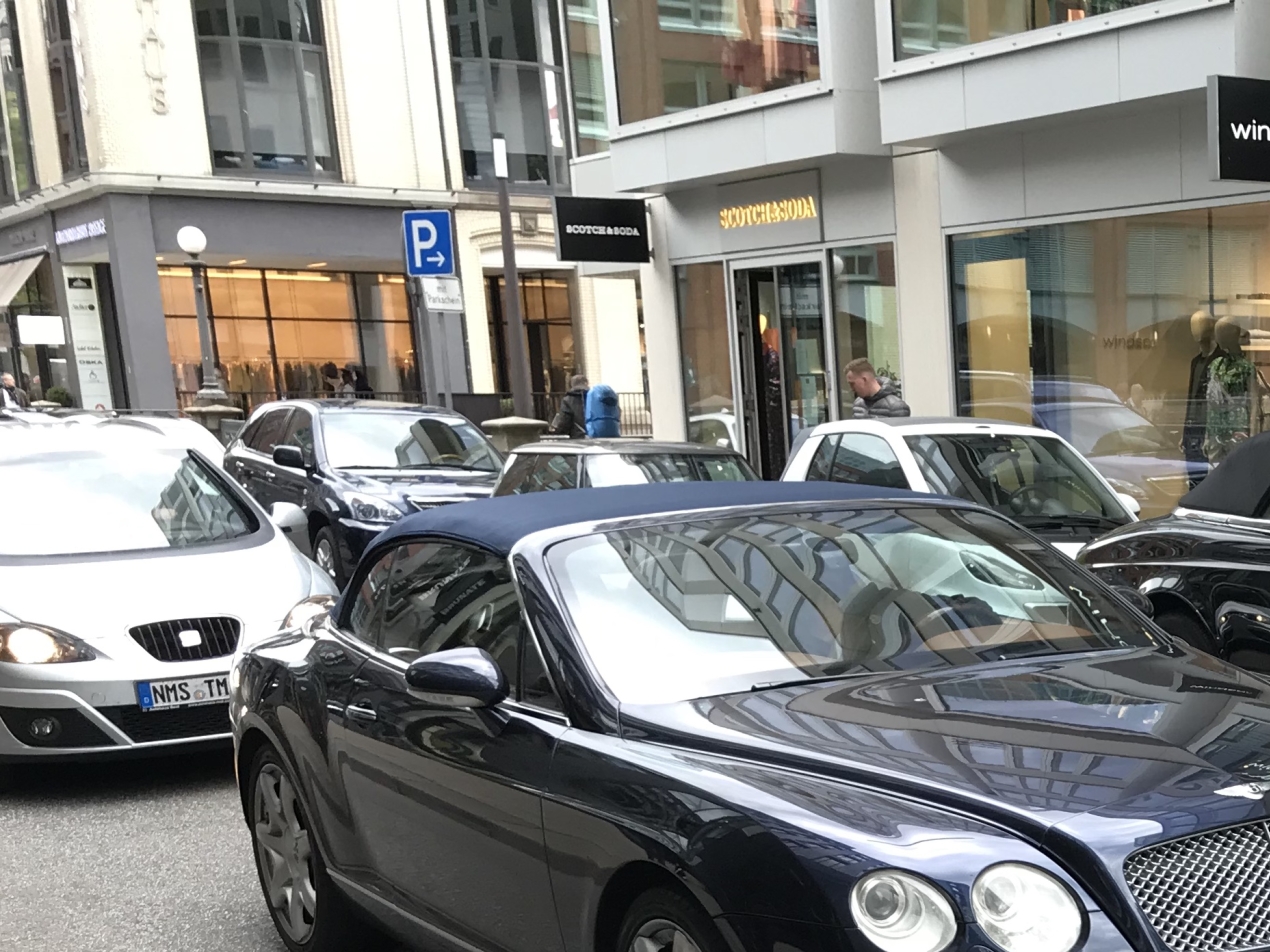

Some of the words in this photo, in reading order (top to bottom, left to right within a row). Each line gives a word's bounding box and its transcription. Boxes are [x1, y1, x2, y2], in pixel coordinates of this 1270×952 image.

[719, 195, 818, 230] SCOTCH&SODA
[411, 219, 438, 268] P
[565, 224, 641, 237] SCOTCH&SODA
[152, 682, 191, 704] NMS
[204, 677, 230, 698] TM
